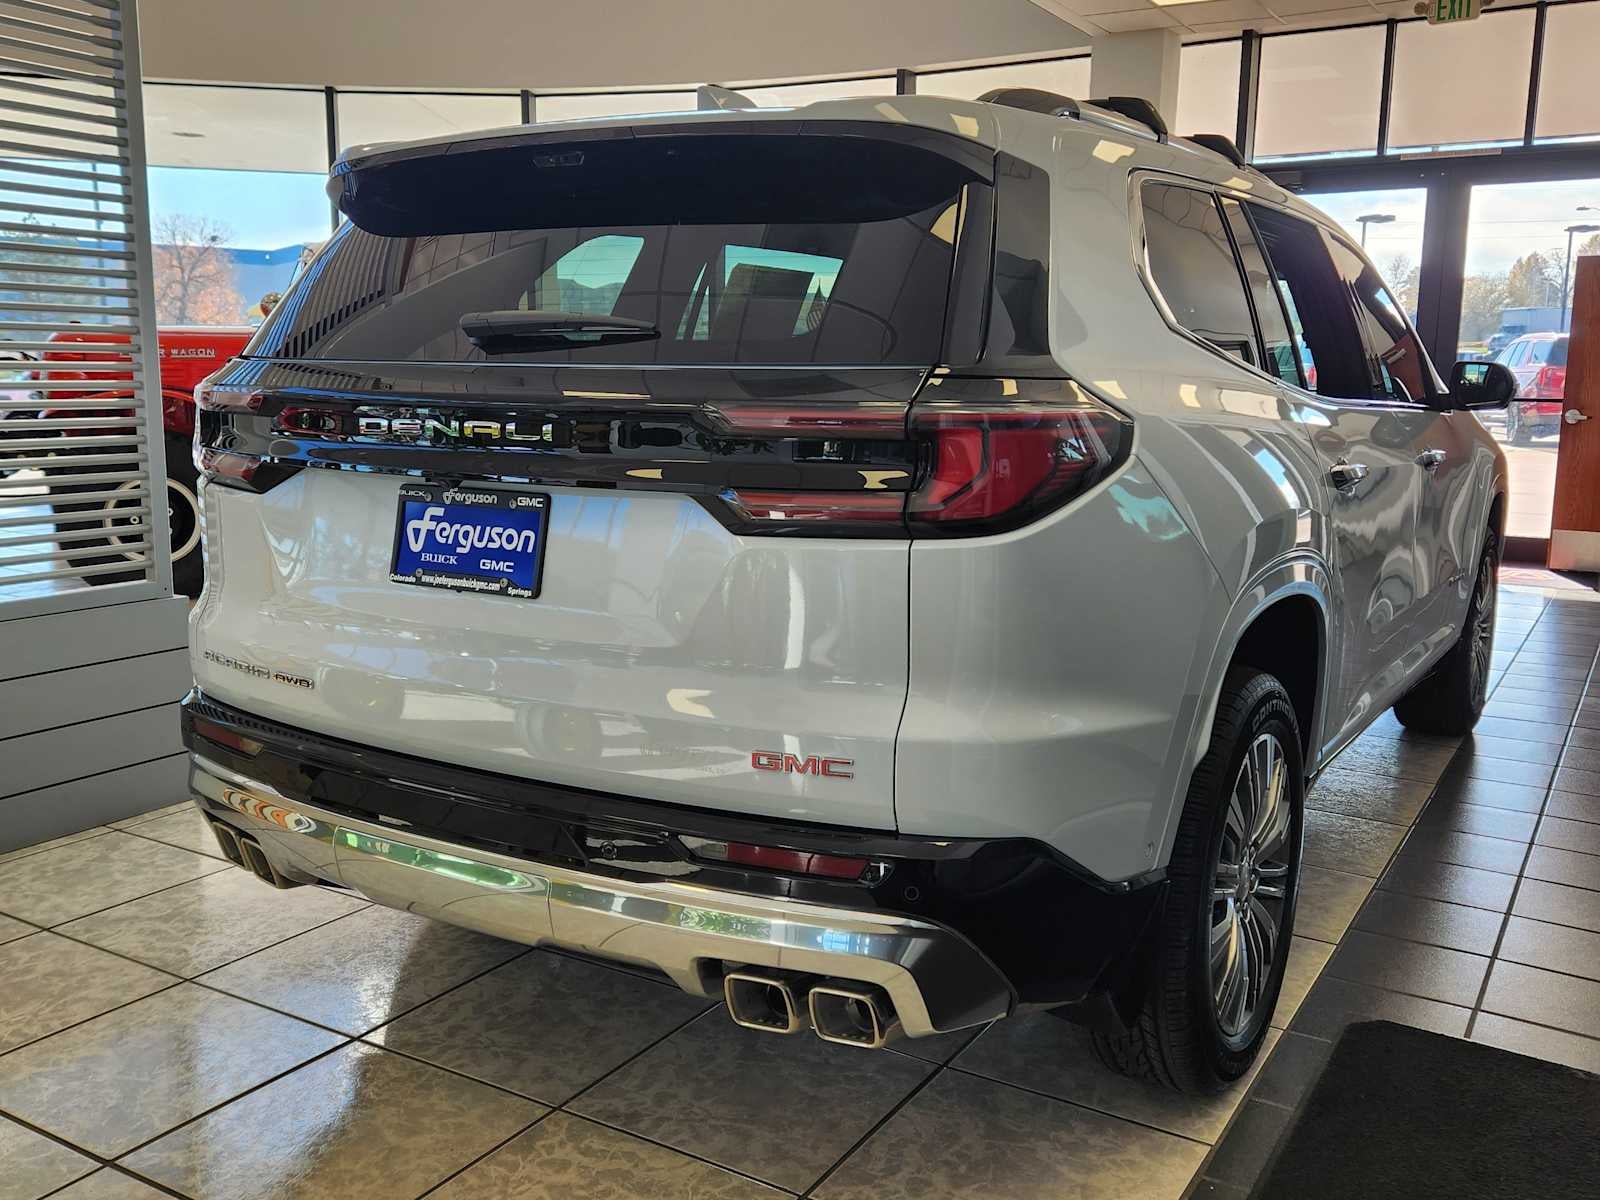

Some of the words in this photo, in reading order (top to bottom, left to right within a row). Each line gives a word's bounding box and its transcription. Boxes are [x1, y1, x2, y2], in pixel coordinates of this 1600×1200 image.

[1436, 0, 1471, 20] EXIT
[170, 348, 216, 357] WAGON
[358, 417, 553, 442] DENALI
[442, 488, 498, 505] Ferguson
[517, 496, 544, 508] GMC
[406, 506, 536, 553] Ferguson
[420, 552, 458, 565] BUICK
[479, 558, 515, 573] GMC
[389, 573, 417, 583] Colorado
[507, 586, 532, 597] Springs
[273, 672, 315, 690] AWD
[751, 750, 855, 779] GMC
